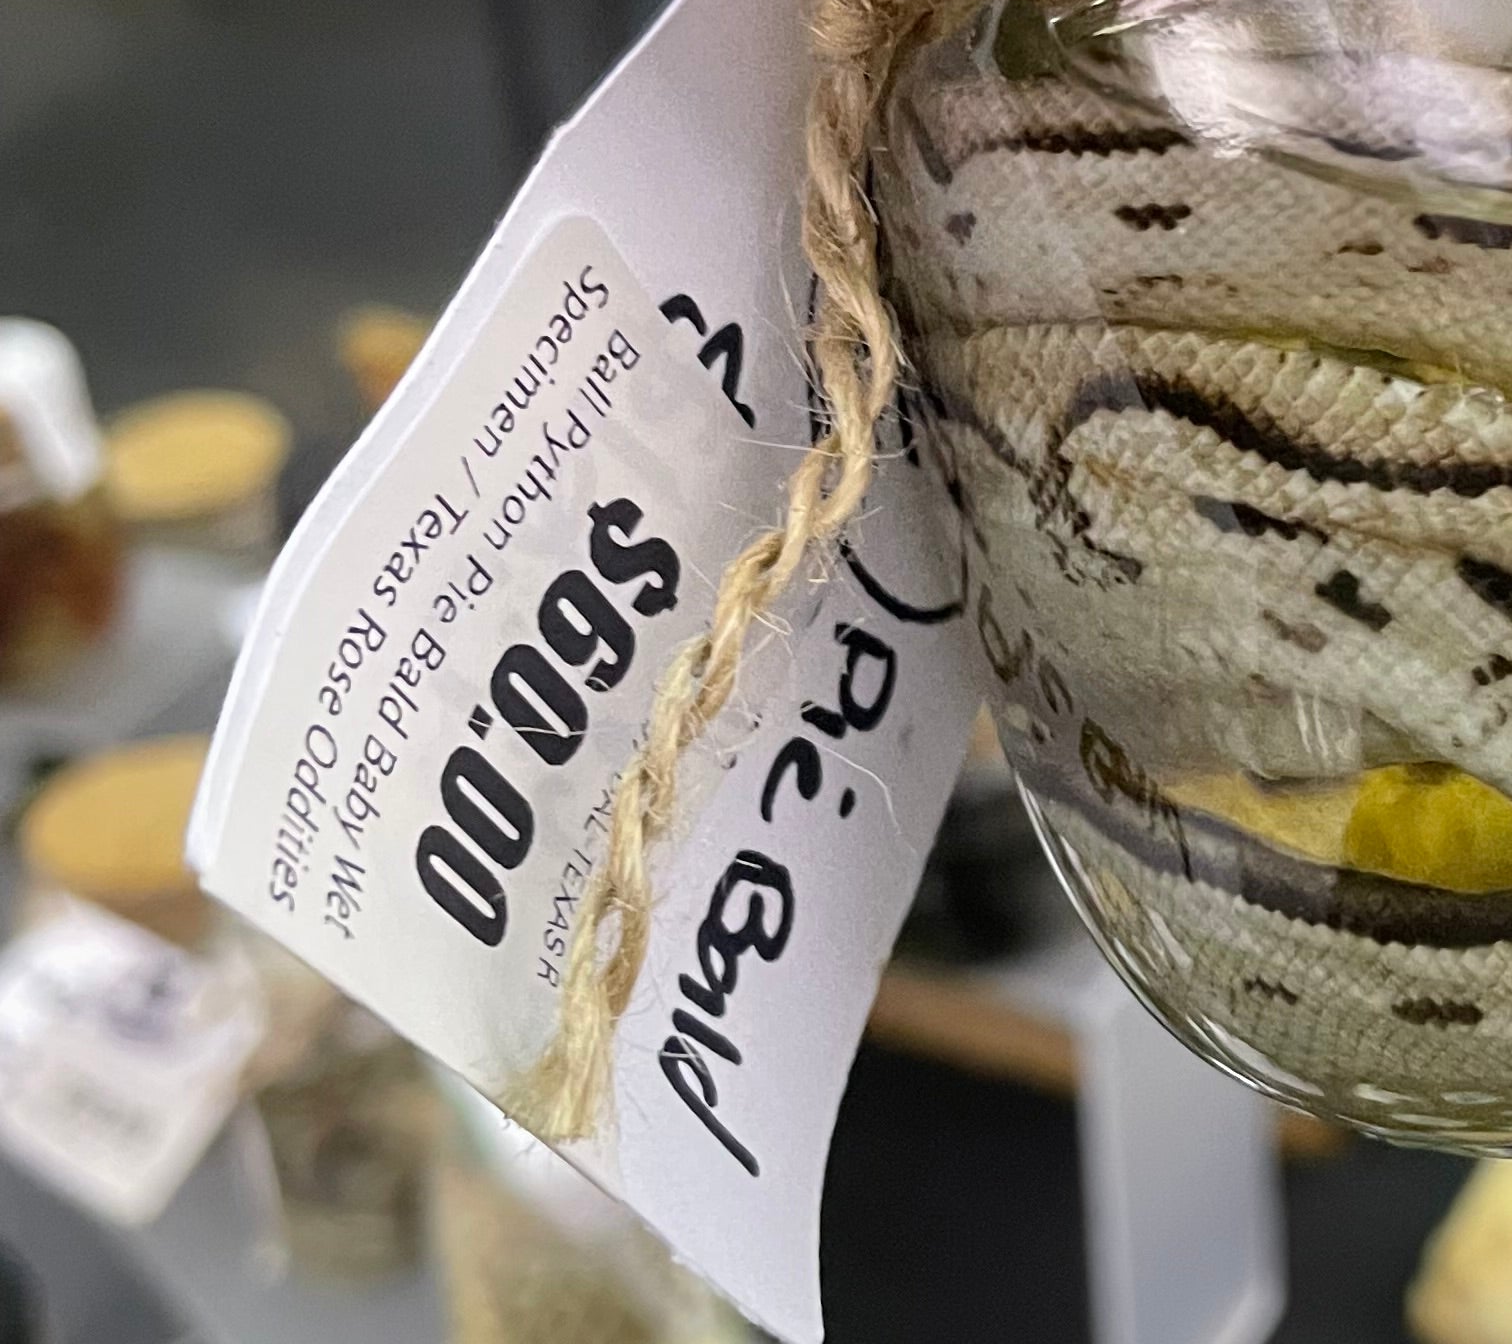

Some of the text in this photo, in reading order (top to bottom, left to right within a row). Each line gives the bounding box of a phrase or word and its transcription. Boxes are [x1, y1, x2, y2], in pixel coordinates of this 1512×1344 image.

[473, 265, 609, 457] Specimen
[323, 328, 641, 940] Ball Python Pie Bald Baby Wet
[373, 493, 470, 607] Texas
[319, 608, 388, 716] Rose
[416, 497, 680, 947] $60.00
[269, 724, 338, 912] Oddities
